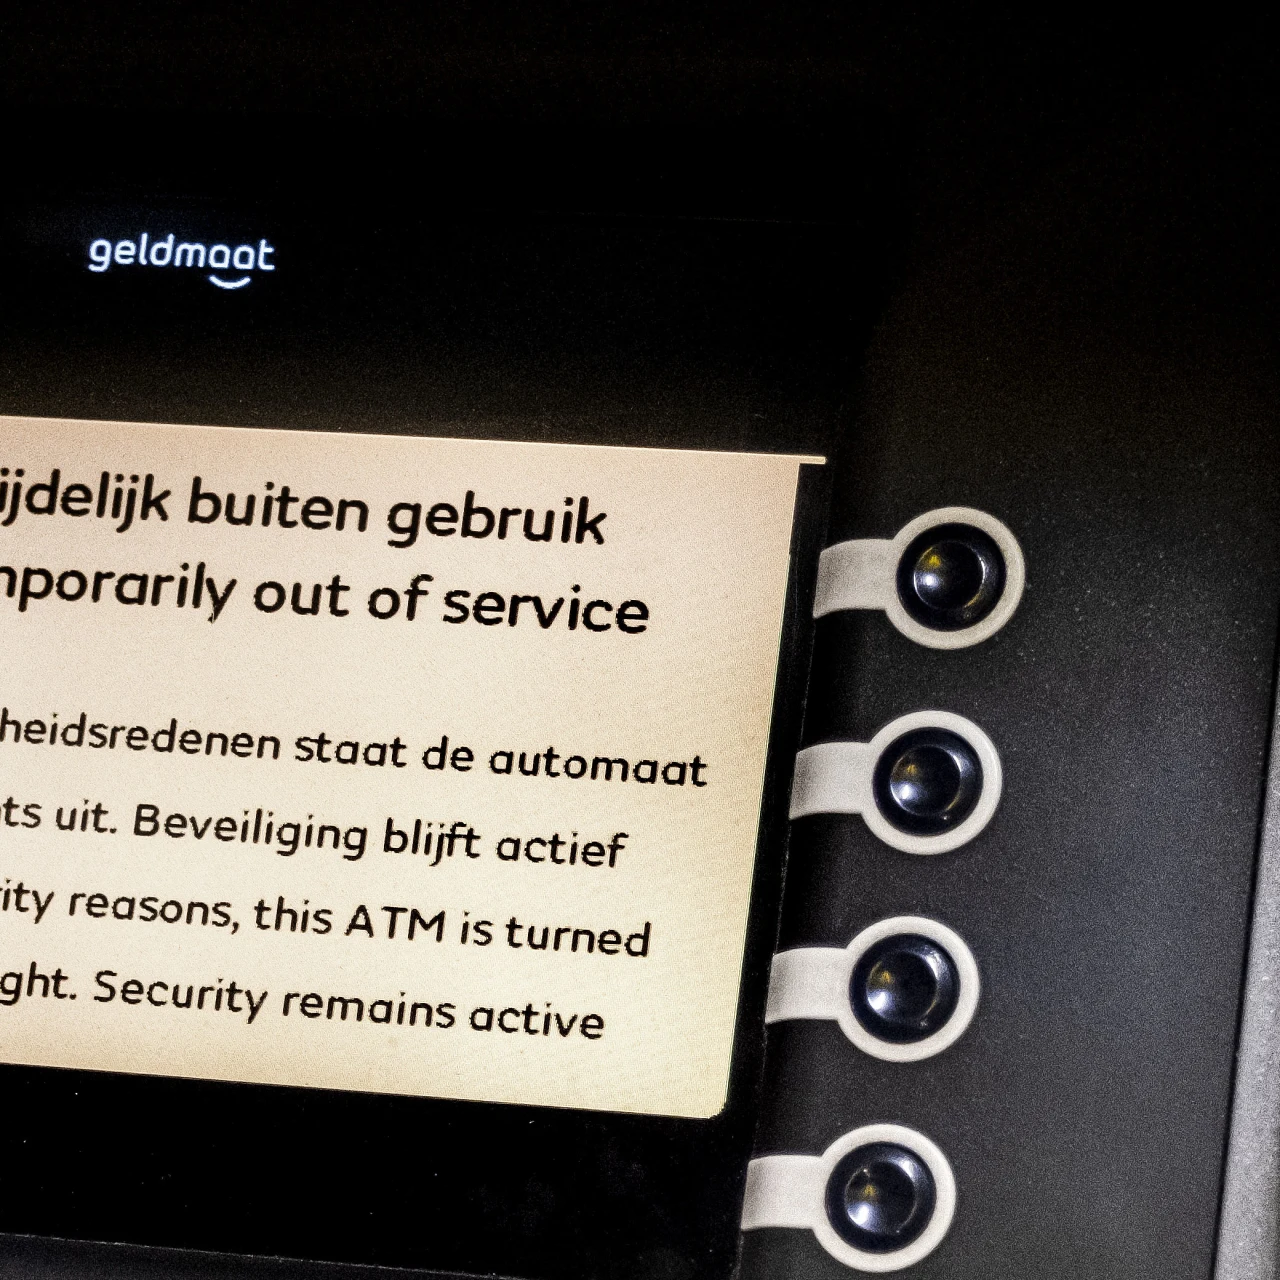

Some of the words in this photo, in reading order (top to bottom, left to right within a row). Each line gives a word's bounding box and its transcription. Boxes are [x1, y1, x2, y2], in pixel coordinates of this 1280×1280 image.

[88, 232, 276, 273] geldmaat
[187, 475, 370, 533] buiten
[386, 489, 608, 549] gebruik
[253, 574, 351, 618] out
[367, 573, 434, 622] of
[442, 583, 650, 635] service
[294, 731, 408, 769] staat
[421, 734, 475, 773] de
[488, 746, 708, 788] automaat
[55, 798, 118, 835] uit.
[132, 802, 369, 862] Beveiliging
[382, 817, 481, 867] blijft
[495, 831, 630, 869] actief
[68, 892, 240, 935] reasons,
[253, 895, 333, 935] this
[344, 904, 446, 943] ATM
[460, 911, 494, 947] is
[505, 916, 652, 958] turned
[92, 969, 269, 1025] Security
[281, 991, 456, 1030] remains
[468, 1002, 605, 1041] active
